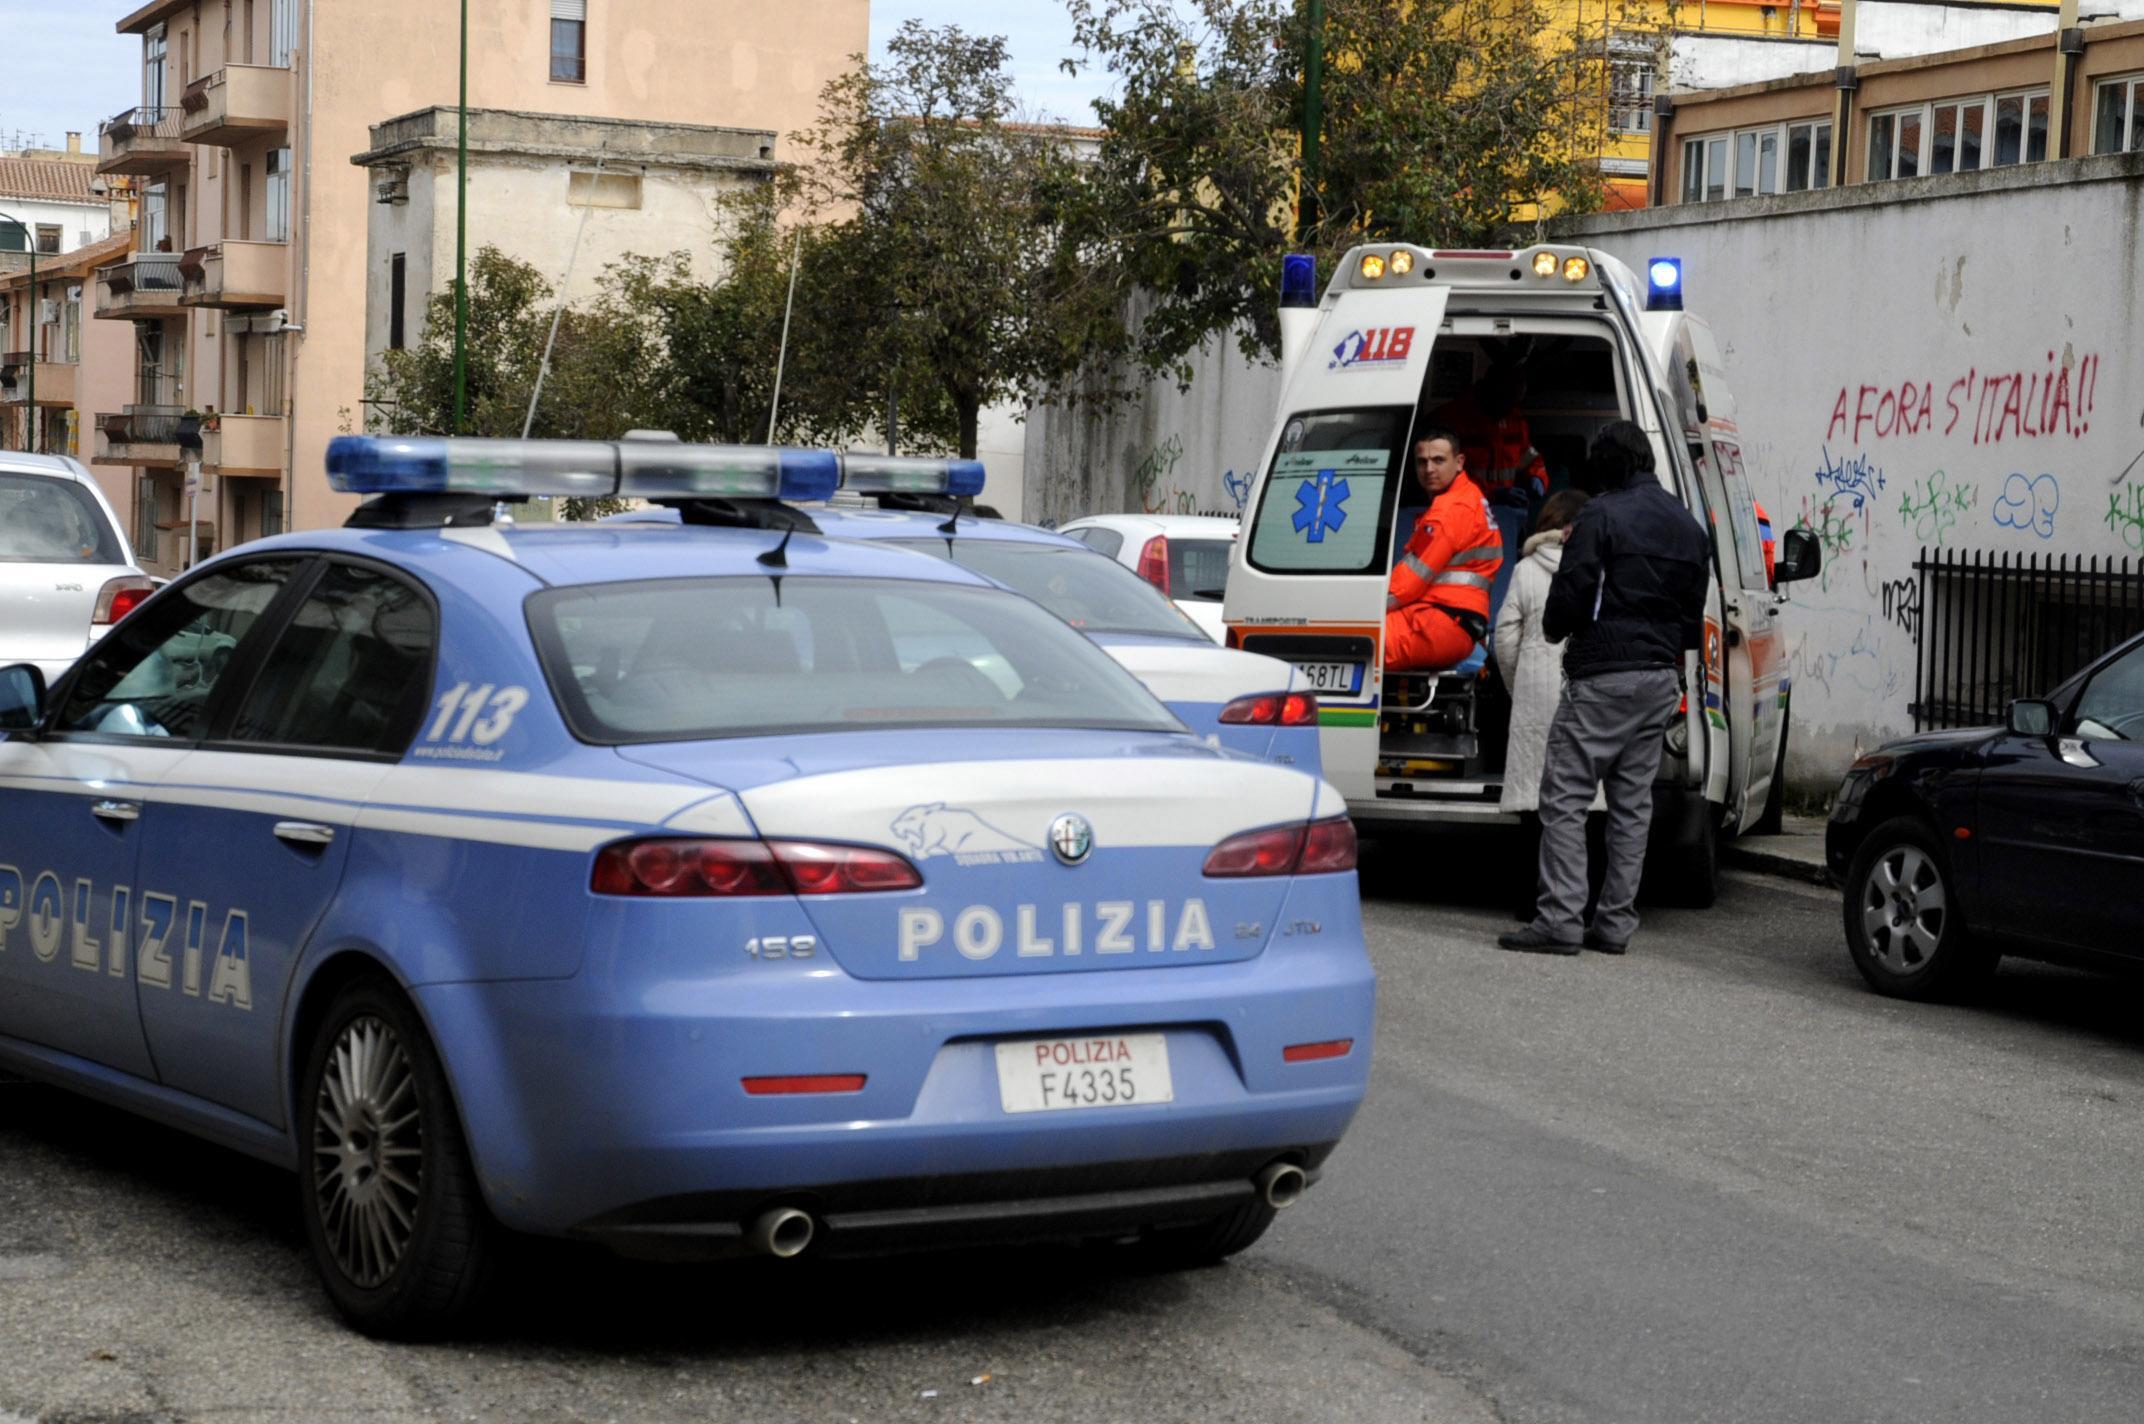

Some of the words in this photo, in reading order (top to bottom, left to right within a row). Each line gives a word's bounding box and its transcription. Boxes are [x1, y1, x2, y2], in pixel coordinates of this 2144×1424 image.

[1359, 326, 1415, 361] 118
[1300, 664, 1348, 688] 68TL
[425, 681, 529, 746] 113
[0, 863, 253, 1011] POLIZIA
[898, 898, 1216, 962] POLIZIA
[1034, 1039, 1132, 1067] POLIZIA
[1041, 1067, 1136, 1106] F4335
